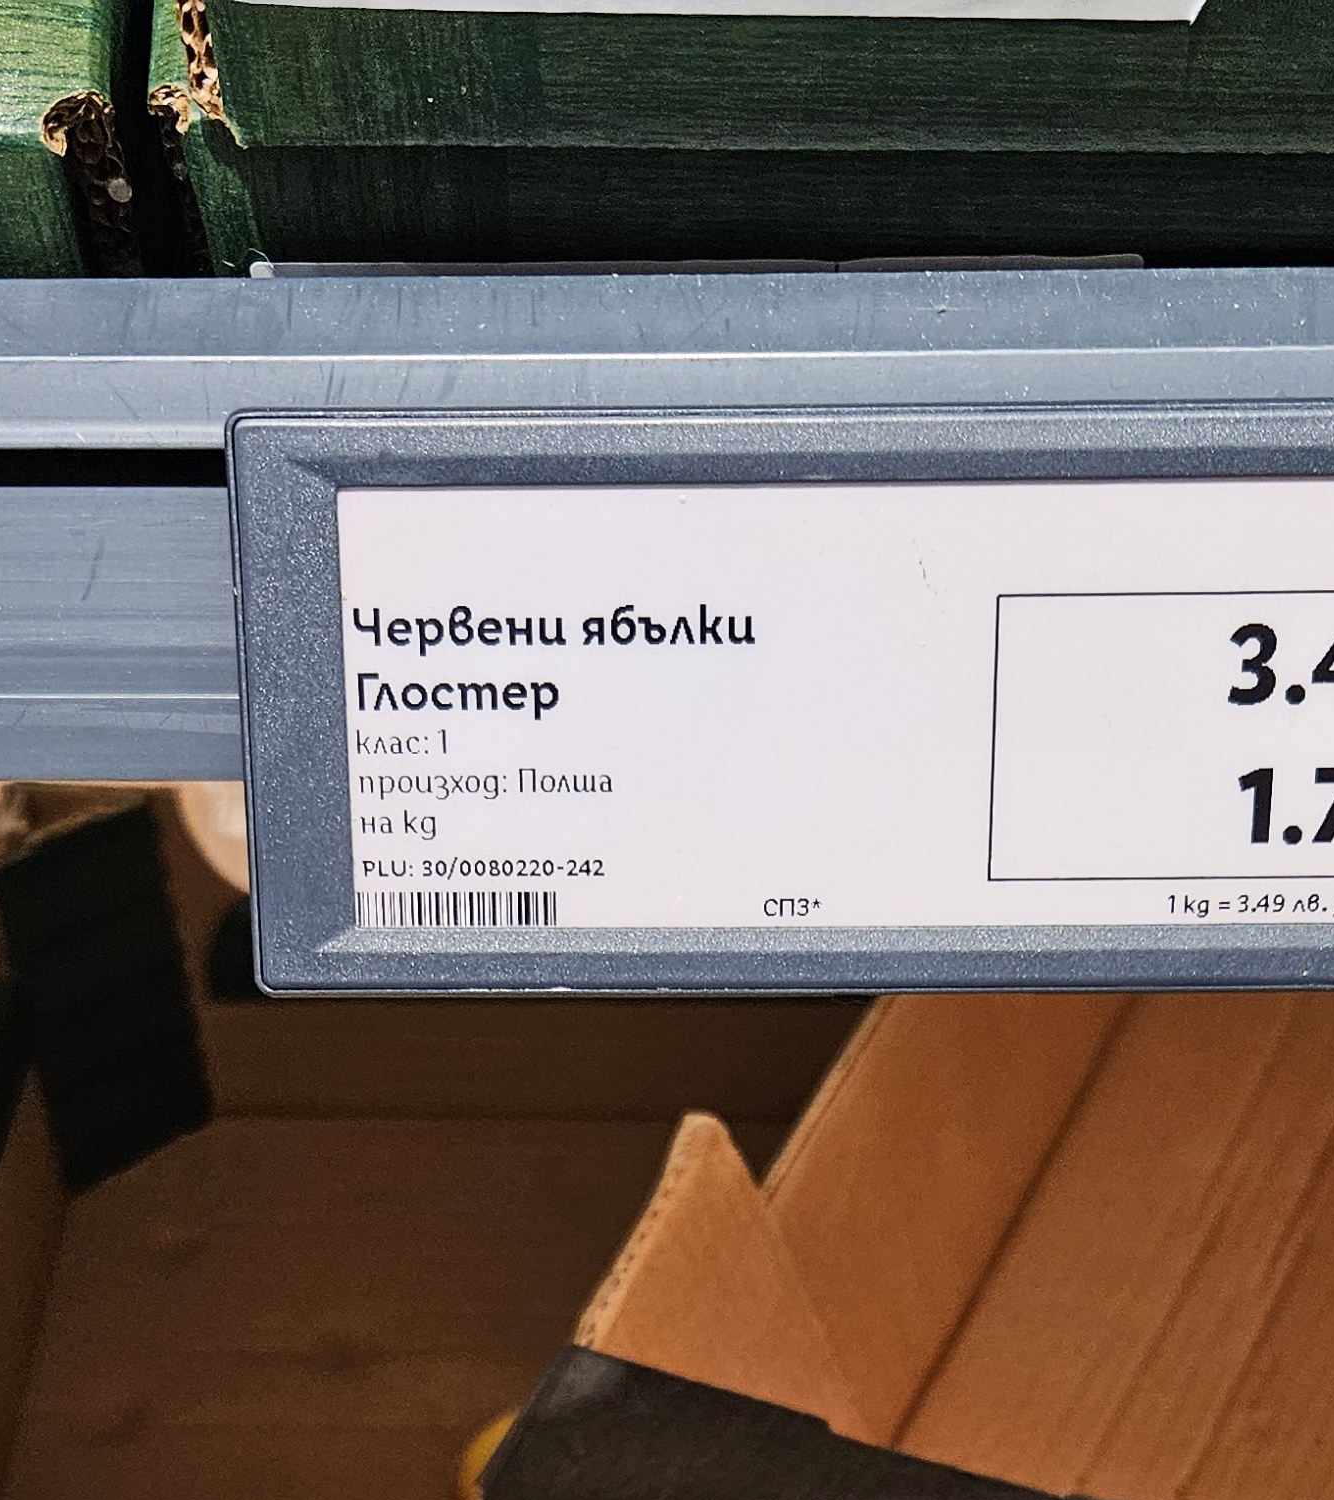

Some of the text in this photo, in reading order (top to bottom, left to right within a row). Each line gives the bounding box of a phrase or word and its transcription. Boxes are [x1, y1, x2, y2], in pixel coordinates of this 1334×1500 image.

[352, 603, 756, 657] Червени ябълки
[357, 672, 559, 721] Глостер
[356, 729, 447, 755] клас: 1
[358, 768, 613, 800] произход: Полша
[360, 809, 437, 841] на kg
[361, 856, 605, 881] PLU: 30/0080220-242
[1167, 894, 1176, 914] 1
[1184, 894, 1210, 919] kg
[1237, 893, 1286, 913] 3.49
[1292, 893, 1328, 913] лв.
